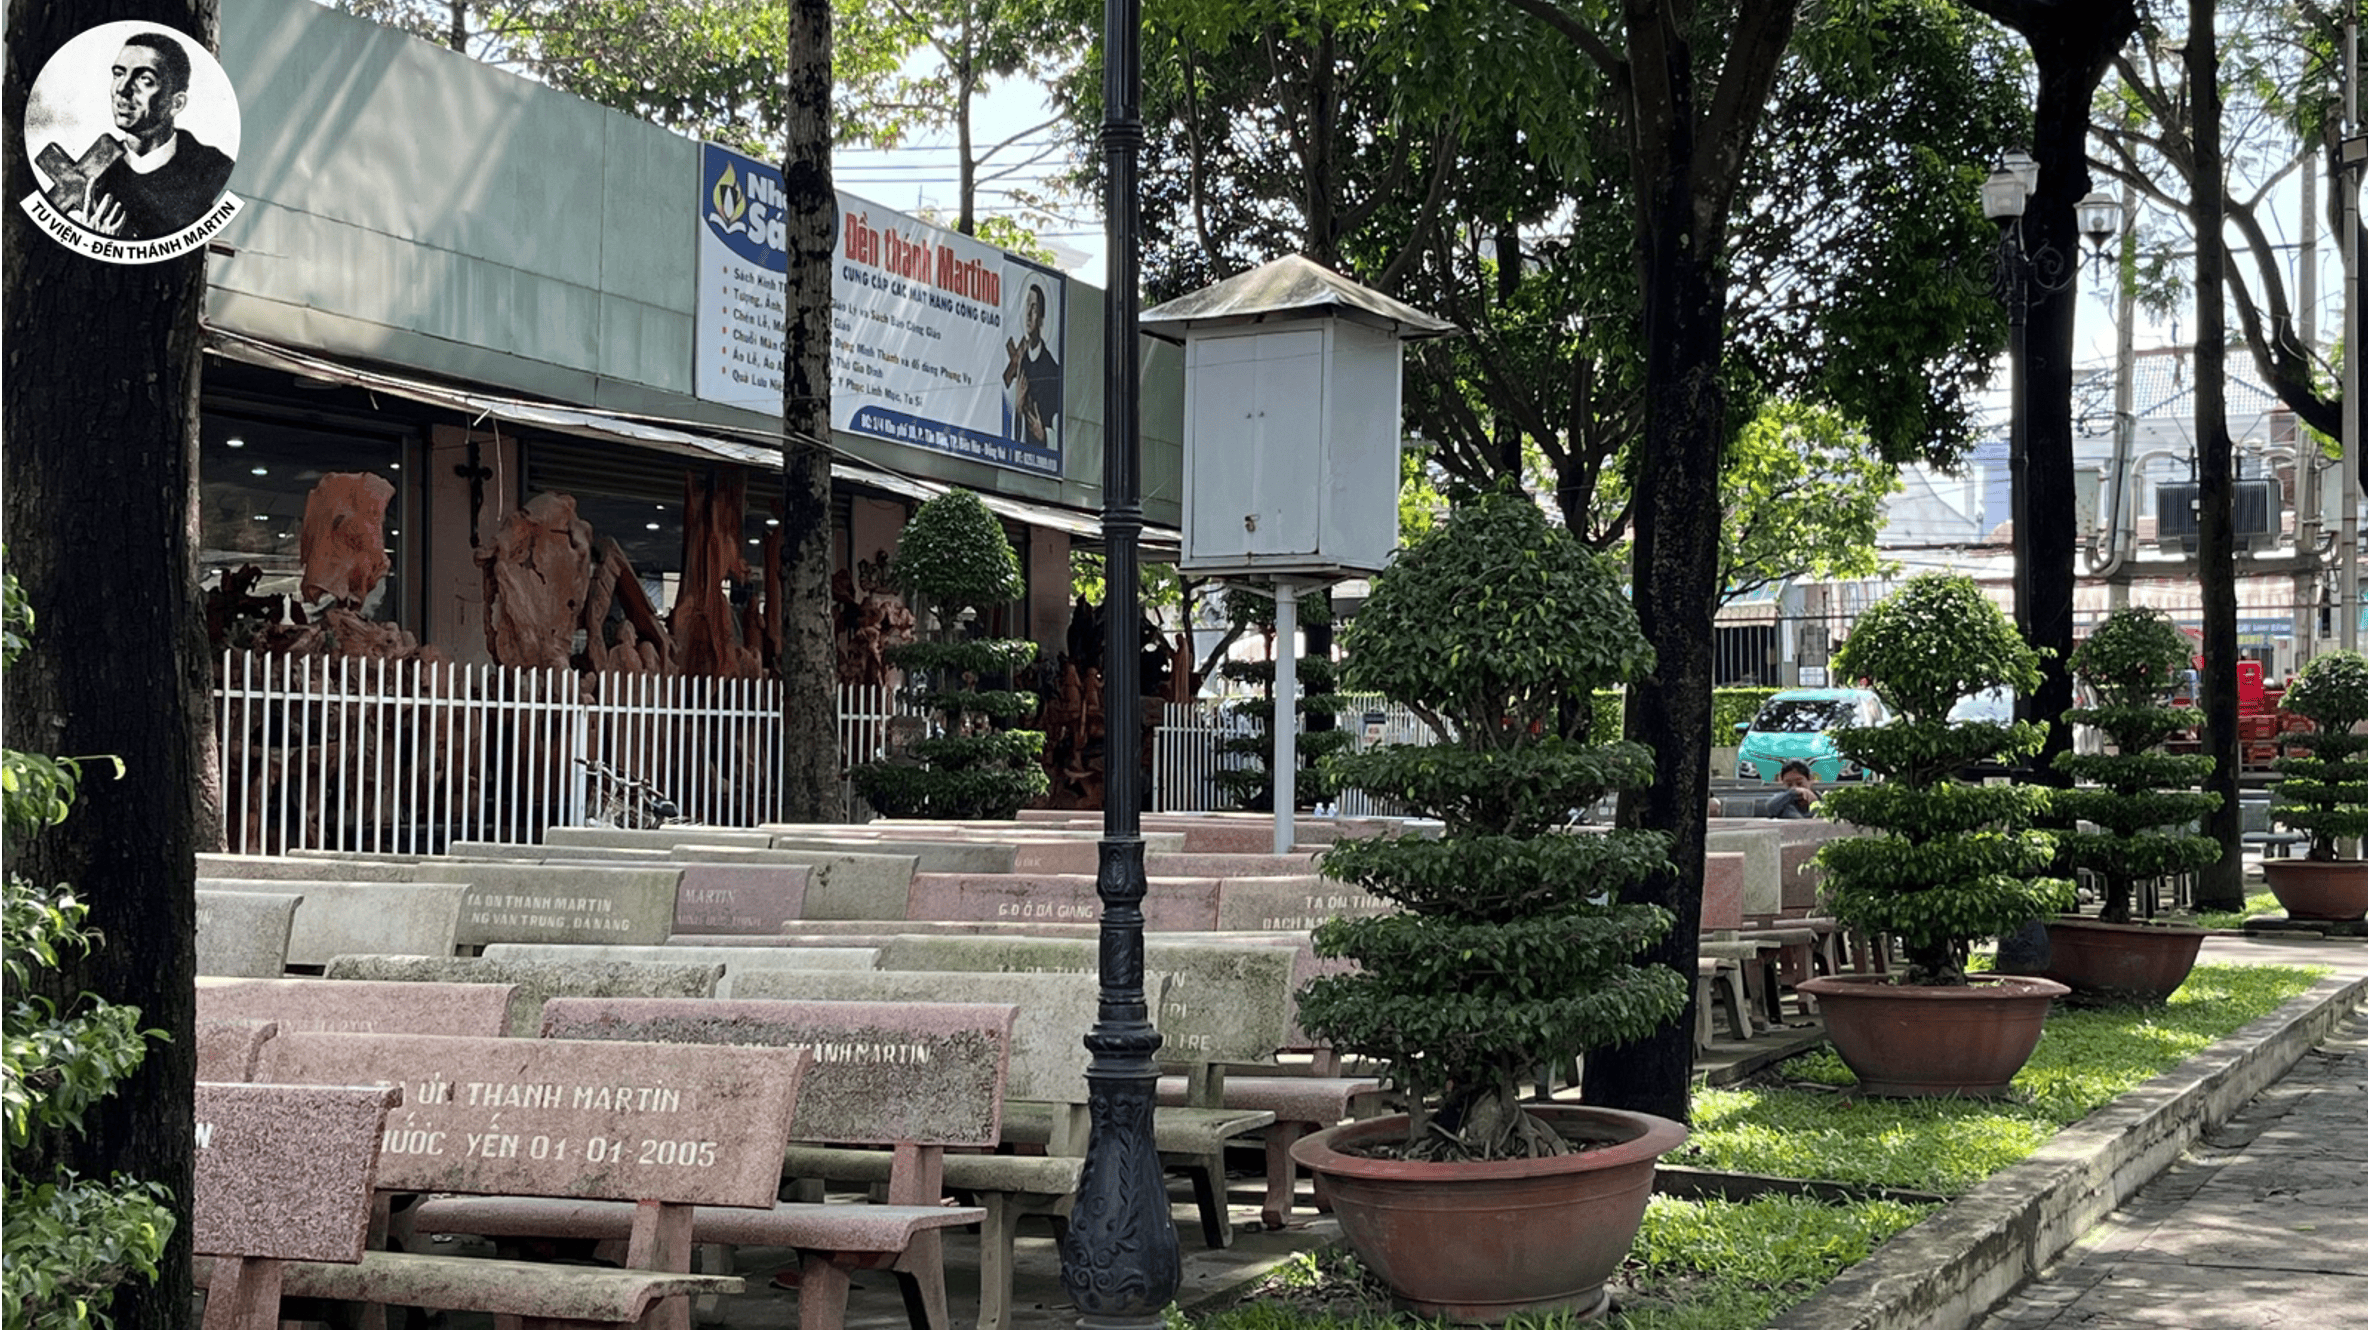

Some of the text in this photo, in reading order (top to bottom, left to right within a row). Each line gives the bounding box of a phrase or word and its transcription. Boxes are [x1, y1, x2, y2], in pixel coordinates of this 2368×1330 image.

[747, 202, 787, 253] Sá
[843, 265, 869, 286] CUNG
[884, 228, 932, 286] thánh
[937, 244, 1000, 308] Martino
[554, 897, 612, 913] MARTIN
